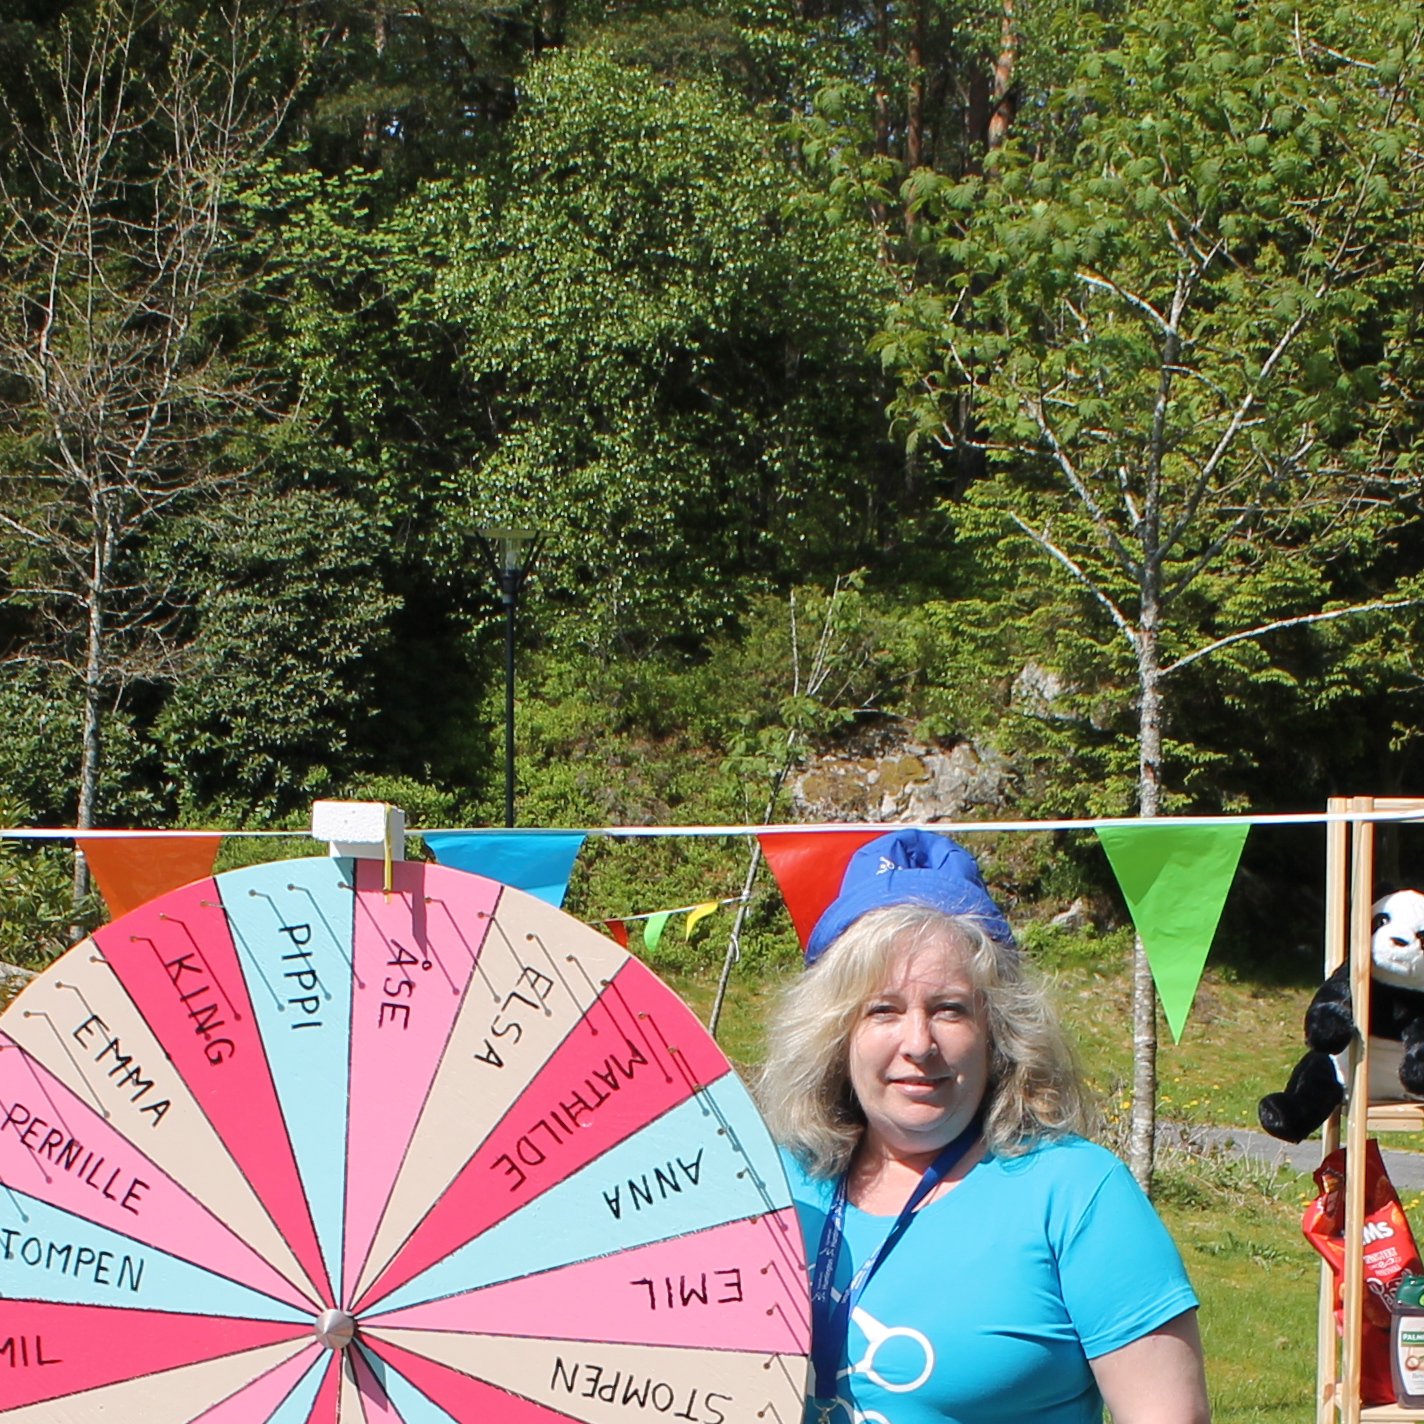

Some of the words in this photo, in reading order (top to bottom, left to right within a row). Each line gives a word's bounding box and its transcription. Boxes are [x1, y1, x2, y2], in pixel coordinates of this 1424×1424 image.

[166, 953, 235, 1066] KING
[279, 923, 322, 1030] PIPPI
[378, 939, 433, 1030] ÅSE
[474, 965, 554, 1068] ELSA
[73, 1014, 171, 1127] EMMA
[490, 1039, 648, 1192] MATHILDE
[0, 1103, 150, 1215] PERNILLE
[602, 1148, 704, 1219] ANNA
[1363, 1221, 1395, 1246] MS
[629, 1268, 744, 1310] EMIL
